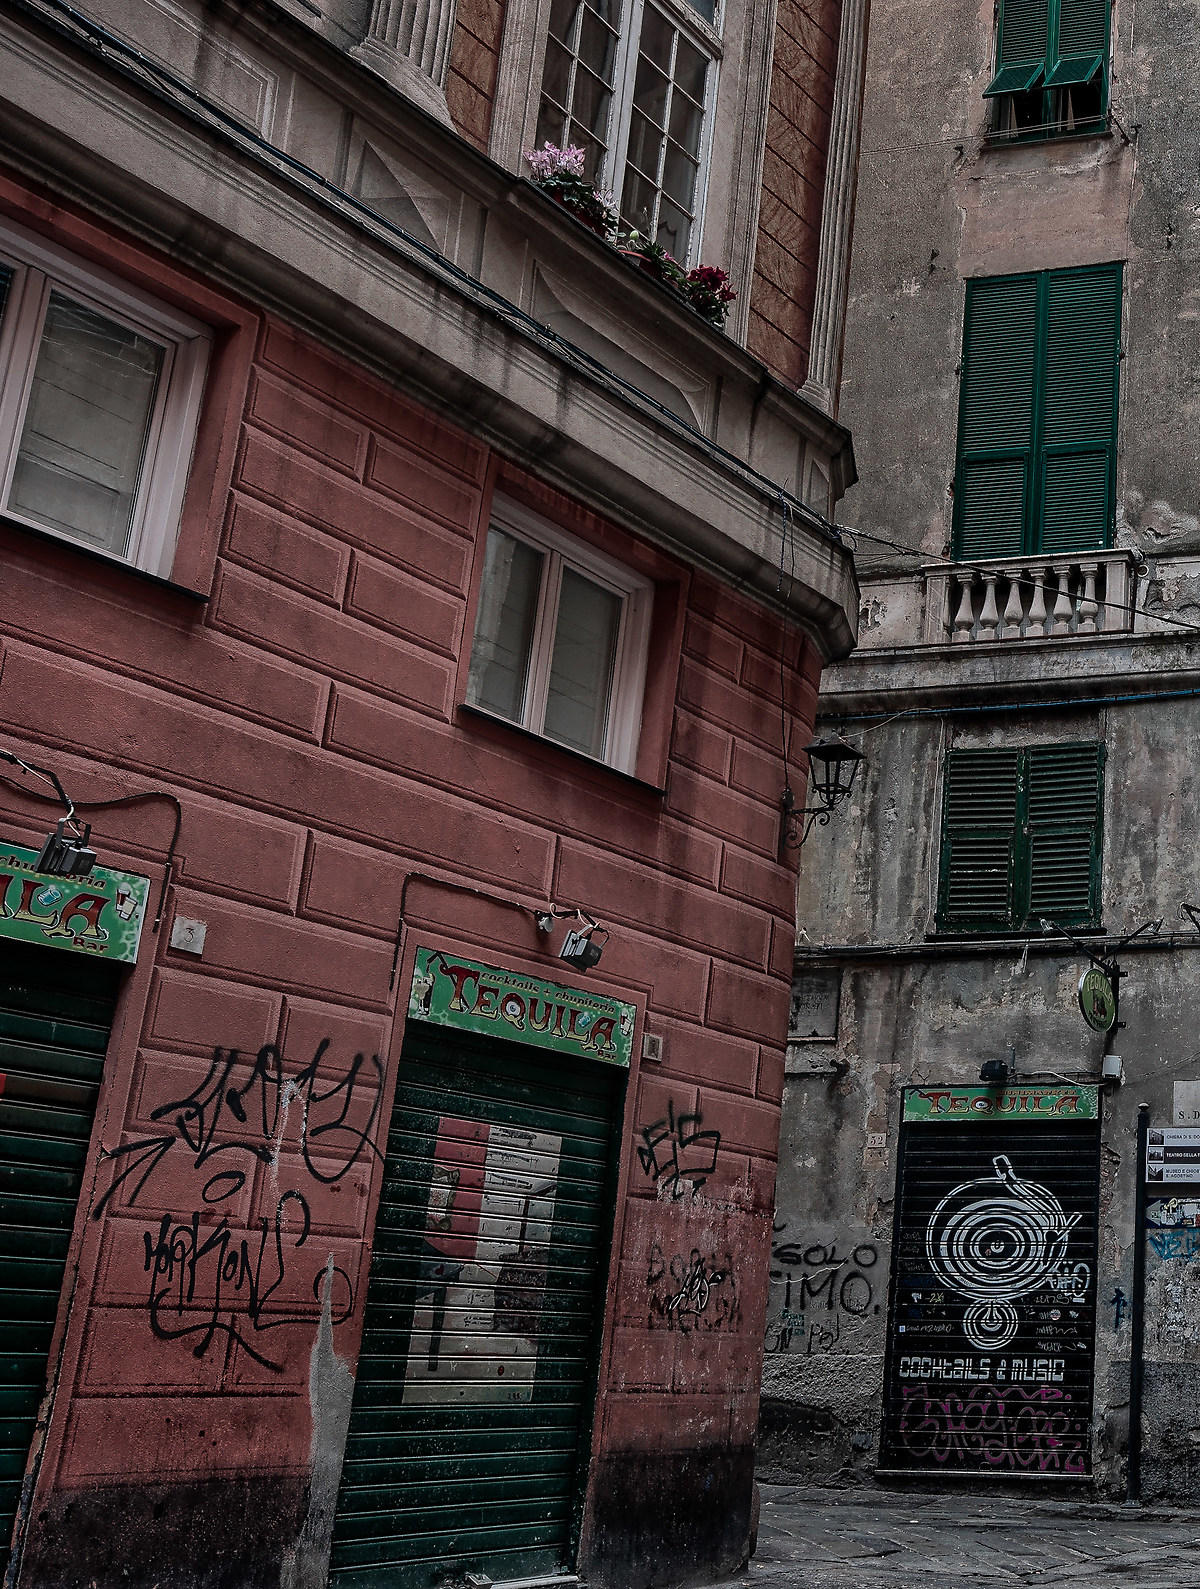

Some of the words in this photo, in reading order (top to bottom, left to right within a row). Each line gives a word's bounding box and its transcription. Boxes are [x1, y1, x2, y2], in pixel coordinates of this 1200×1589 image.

[72, 936, 109, 952] Bar
[184, 926, 195, 943] 3
[481, 971, 541, 994] cocktails
[439, 964, 618, 1051] TEQUILA
[597, 1049, 617, 1060] Bar
[918, 1091, 1082, 1116] TEQUILA
